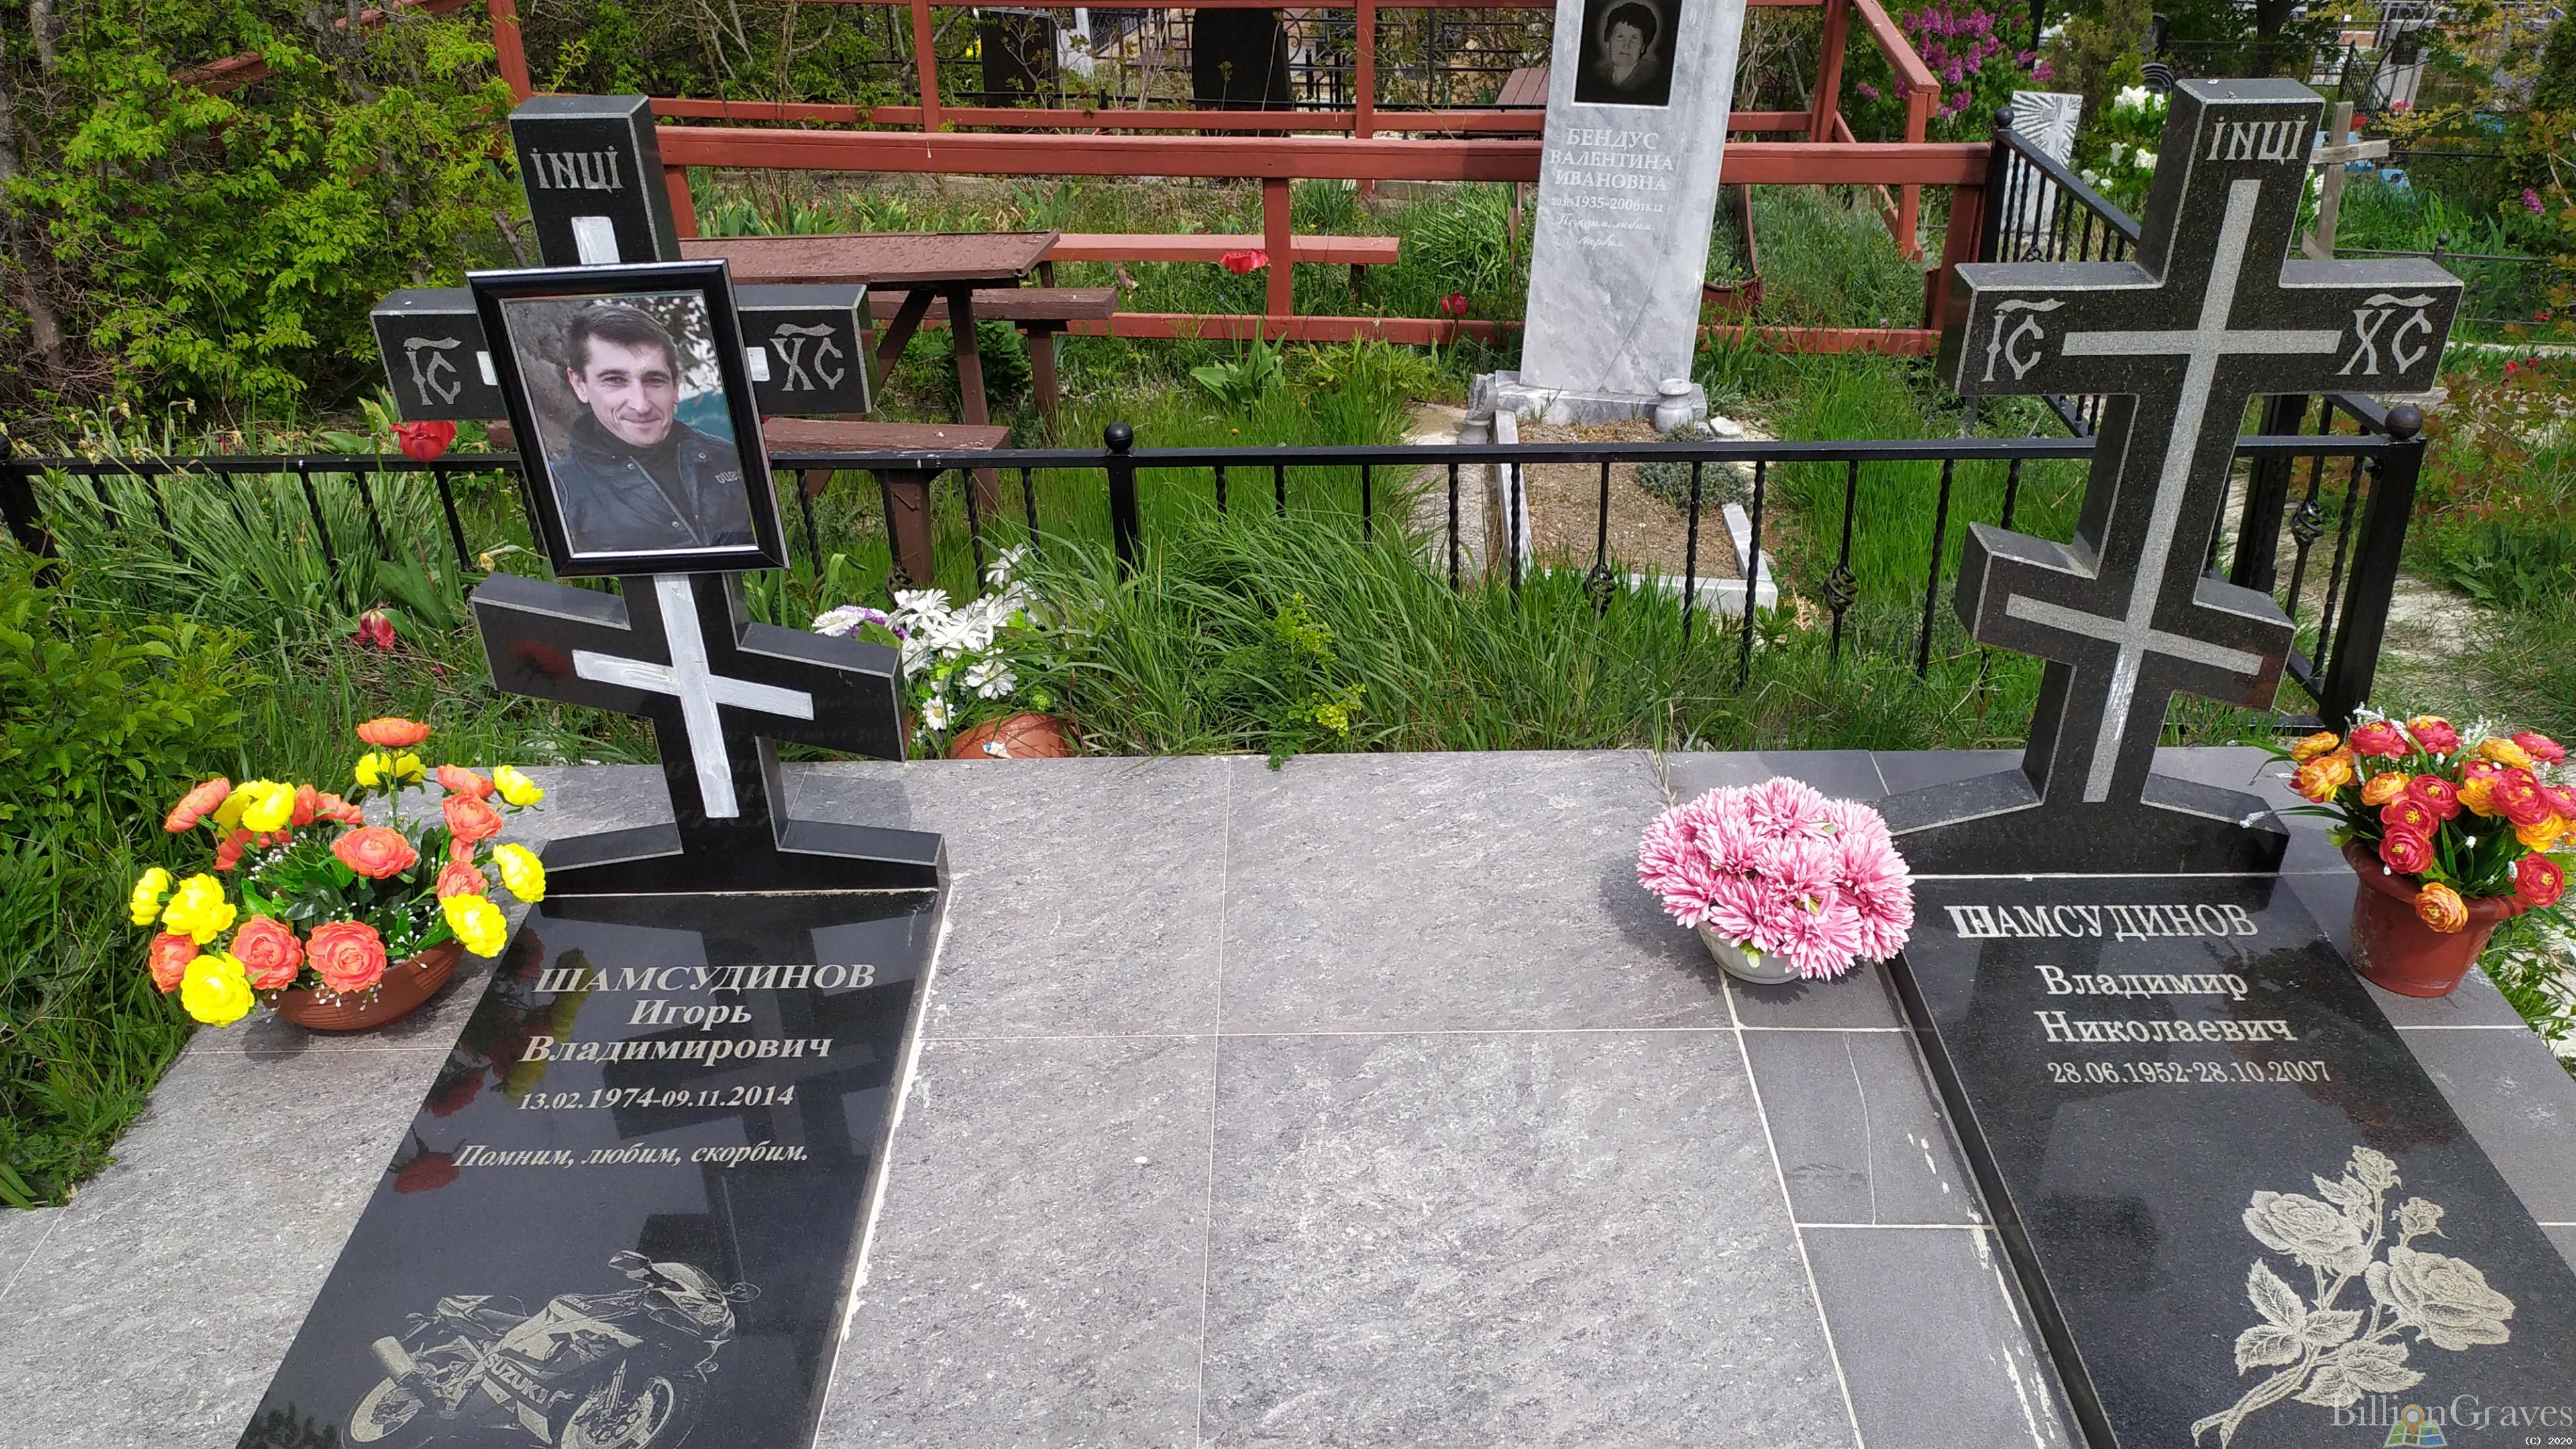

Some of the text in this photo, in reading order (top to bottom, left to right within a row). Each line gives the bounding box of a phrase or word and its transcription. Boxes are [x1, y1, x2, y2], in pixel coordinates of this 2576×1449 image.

[1566, 127, 1659, 151] БЕНДУС
[1549, 149, 1674, 170] ВАЛЕНТИНА
[1554, 170, 1668, 191] ИВАНОВНА
[1945, 904, 2259, 942] ШАМСУДИНОВ
[531, 963, 875, 996] ШАМСУДИНОВ
[2035, 964, 2248, 1001] Владимир
[626, 999, 752, 1031] Игорь
[2034, 1010, 2298, 1043] Николаевич
[517, 1034, 833, 1067] Владимирович
[2047, 1061, 2331, 1084] 28.06.1952-28.10.2007
[517, 1084, 794, 1110] 13.02.1974-09.11.2014
[453, 1142, 808, 1169] Помним, любим, скорбим.
[483, 1352, 549, 1405] SUZUKI
